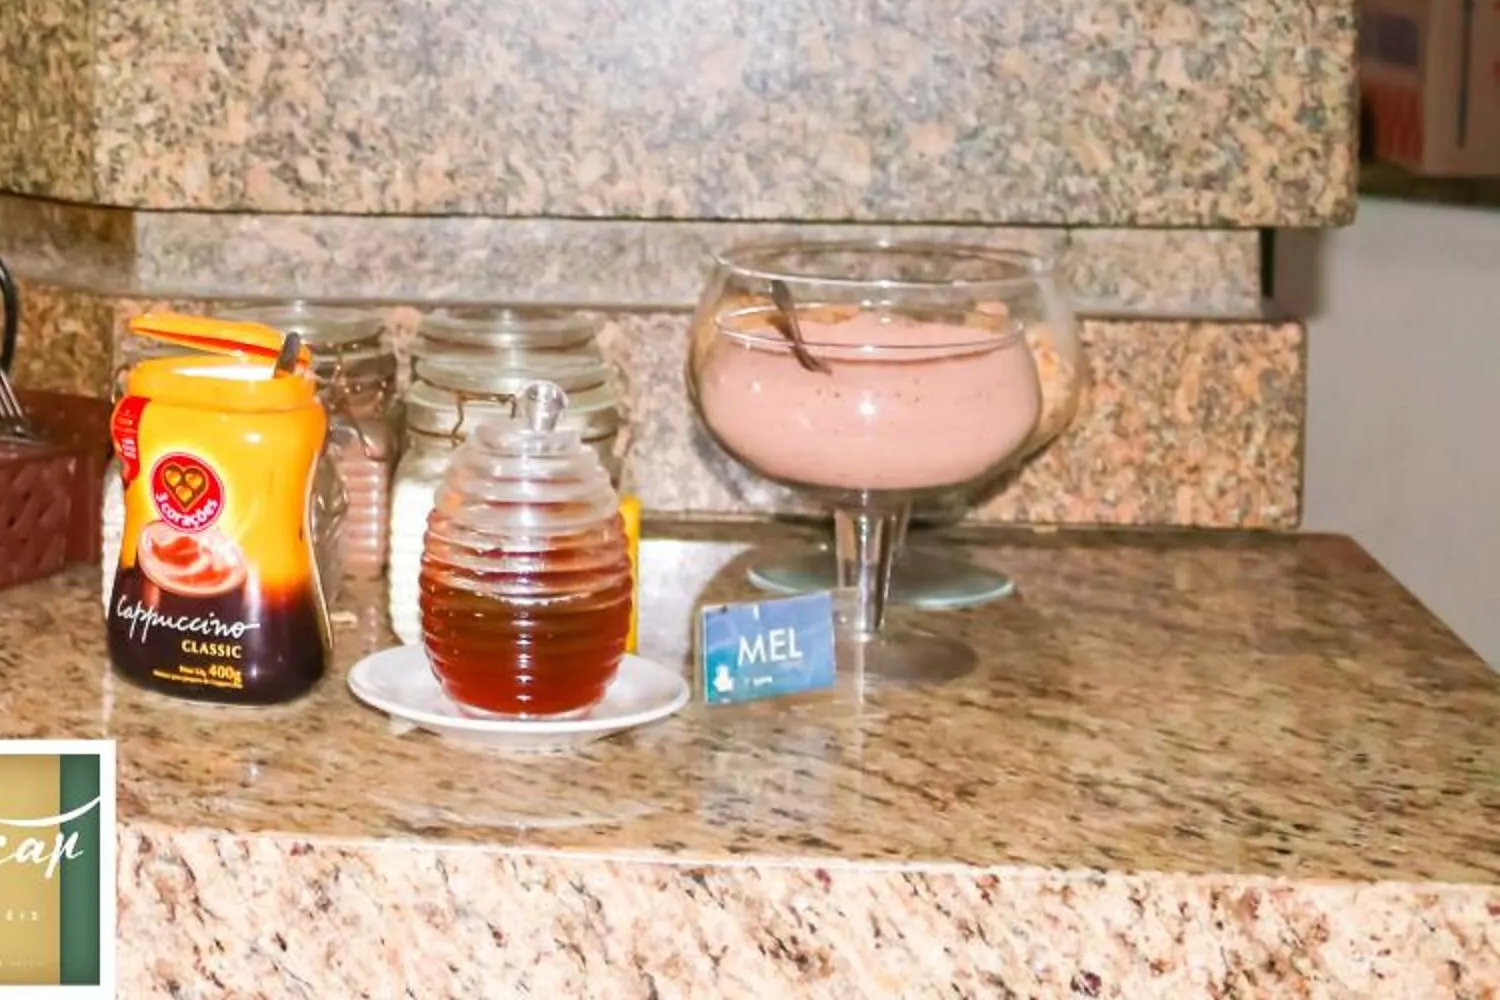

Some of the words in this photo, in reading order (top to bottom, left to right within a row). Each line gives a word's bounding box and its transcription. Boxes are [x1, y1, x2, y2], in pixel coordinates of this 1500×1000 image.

[116, 594, 260, 644] Cappuccino
[181, 639, 242, 659] CLASSIC
[737, 626, 803, 668] MEL
[208, 663, 243, 686] 400g
